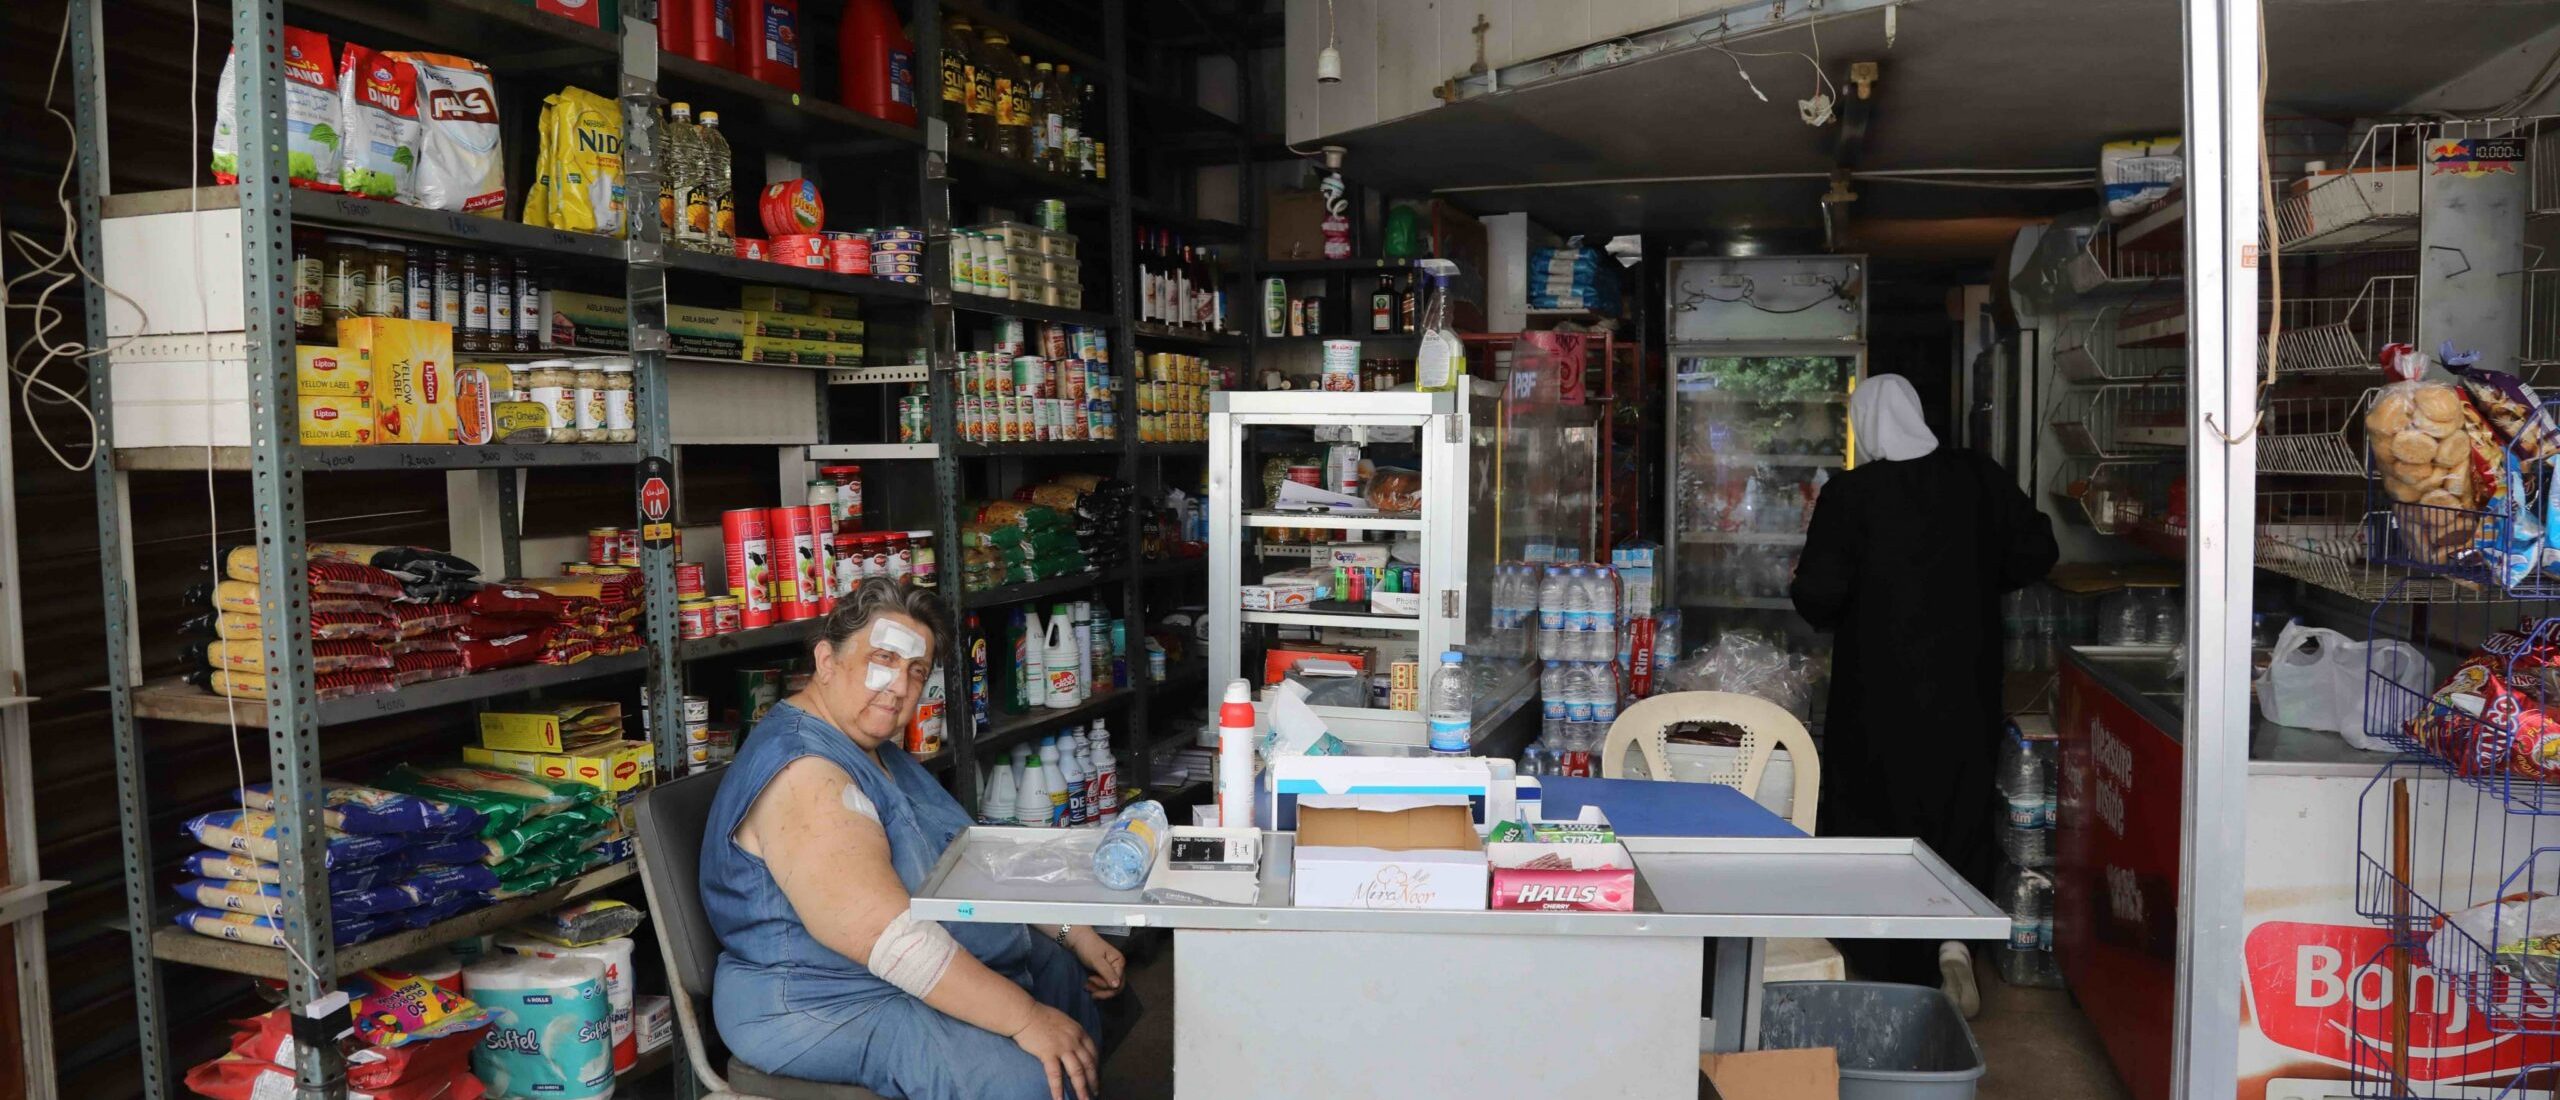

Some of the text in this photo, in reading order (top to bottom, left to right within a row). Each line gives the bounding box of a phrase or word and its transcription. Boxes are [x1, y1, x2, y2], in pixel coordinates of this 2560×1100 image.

[314, 360, 337, 369] Lipton
[301, 379, 351, 389] YELLOW LABEL
[392, 363, 403, 400] LABEL
[400, 358, 413, 405] YELLOW
[424, 364, 436, 401] Lipton
[315, 409, 337, 418] Lipton
[301, 430, 352, 439] YELLOW LABEL
[1634, 648, 1649, 676] Rim
[1517, 884, 1597, 904] HALLS
[605, 963, 618, 981] 4
[407, 1000, 427, 1017] 50
[579, 1013, 610, 1043] Softel
[486, 1027, 540, 1051] Softel
